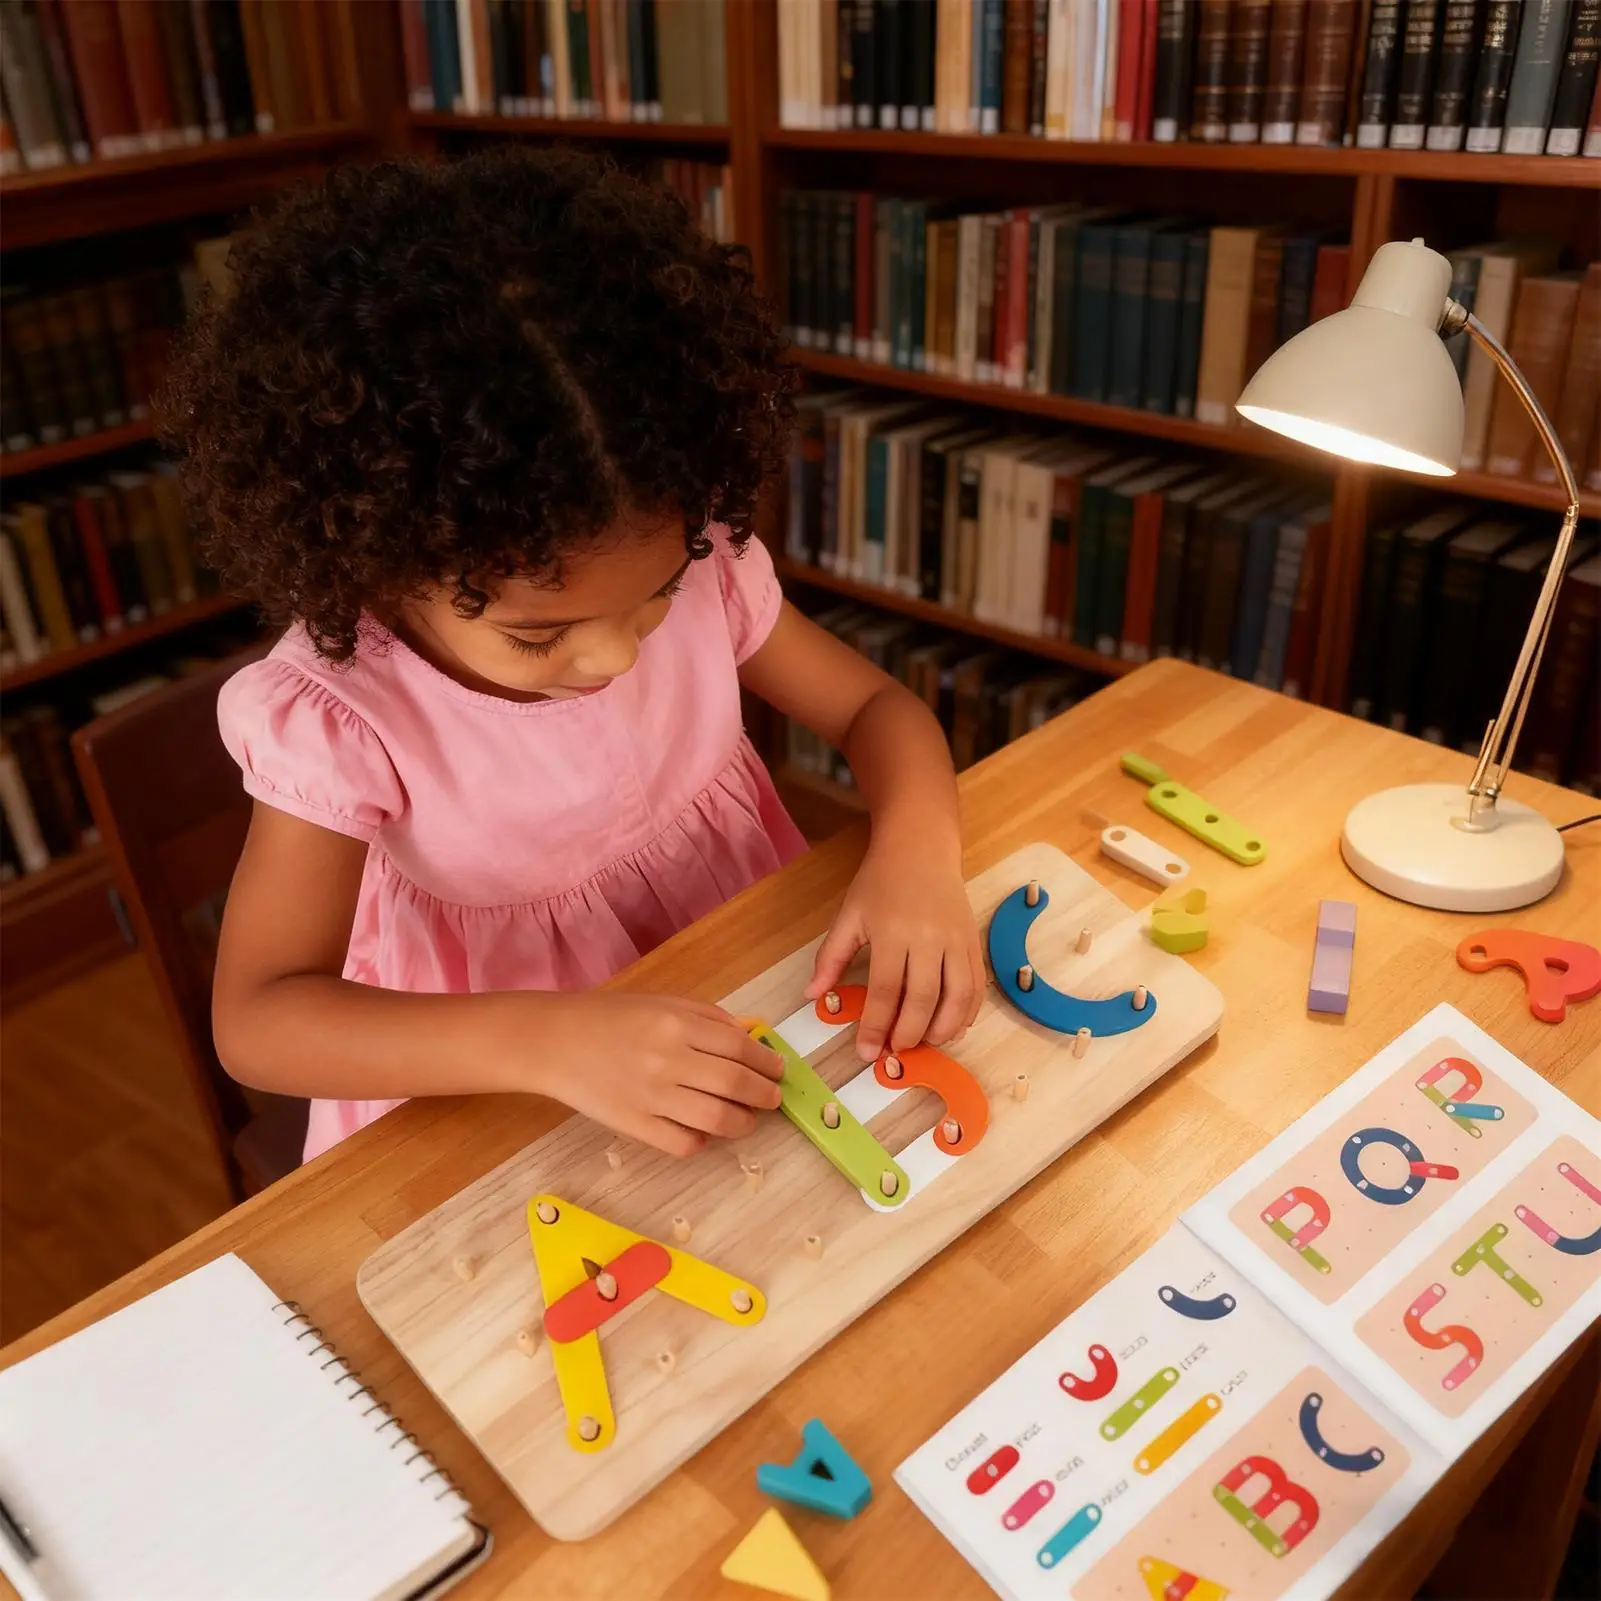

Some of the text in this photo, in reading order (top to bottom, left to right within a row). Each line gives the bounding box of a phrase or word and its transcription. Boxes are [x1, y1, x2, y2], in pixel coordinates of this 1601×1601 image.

[528, 1194, 767, 1454] A
[990, 880, 1157, 1038] C
[1261, 1057, 1505, 1274] P Q R
[1403, 1283, 1484, 1391] S
[1451, 1222, 1544, 1308] T
[1212, 1455, 1320, 1559] B
[1299, 1392, 1385, 1472] C
